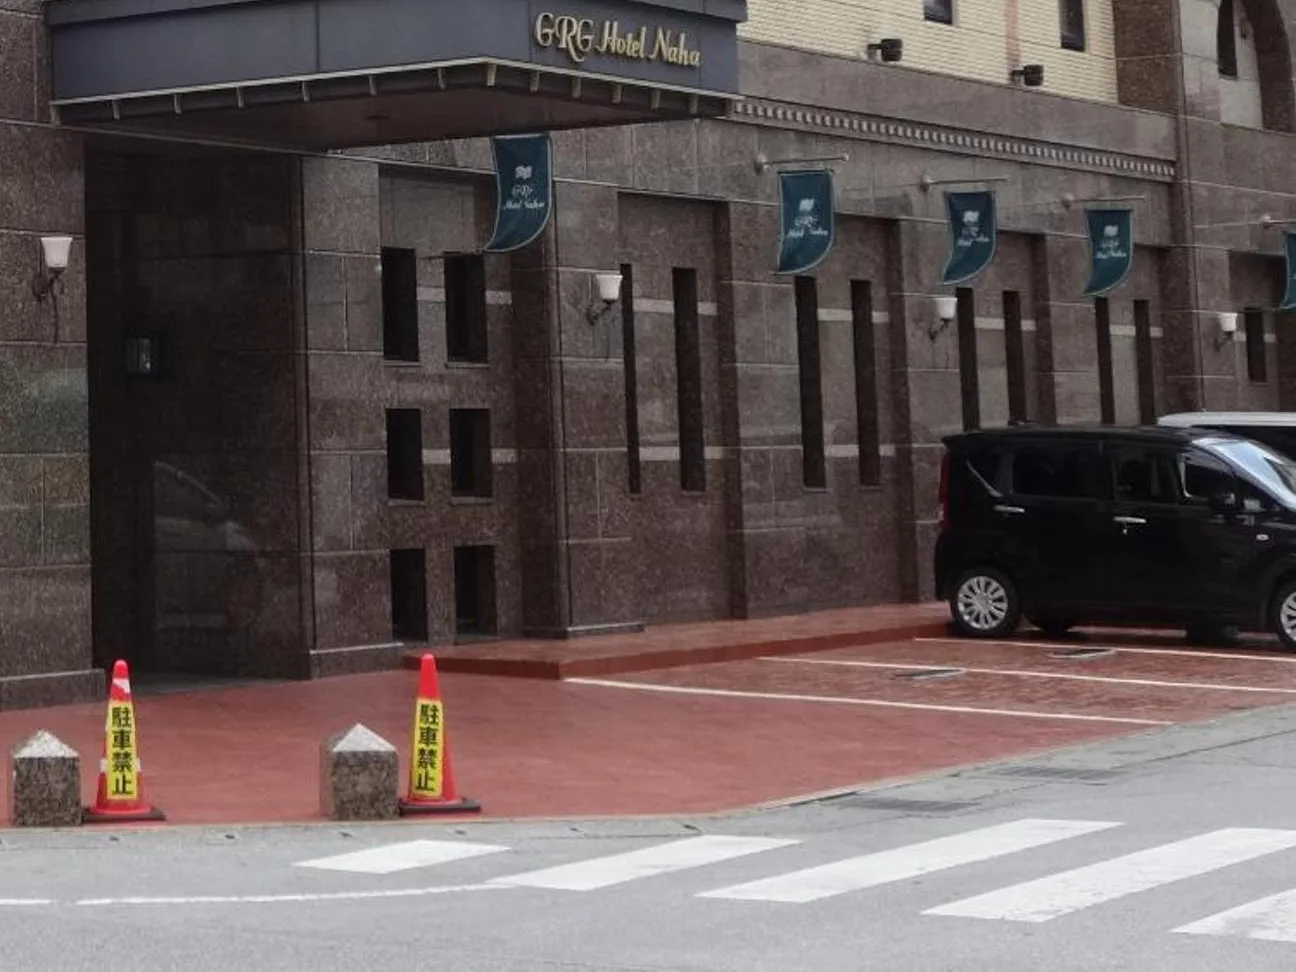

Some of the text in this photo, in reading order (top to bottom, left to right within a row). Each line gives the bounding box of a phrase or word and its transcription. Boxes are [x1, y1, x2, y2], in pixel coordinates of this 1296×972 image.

[535, 12, 700, 66] GRG Hotel Naha
[111, 707, 133, 795] 駐車禁止
[415, 704, 440, 792] 駐車禁止
